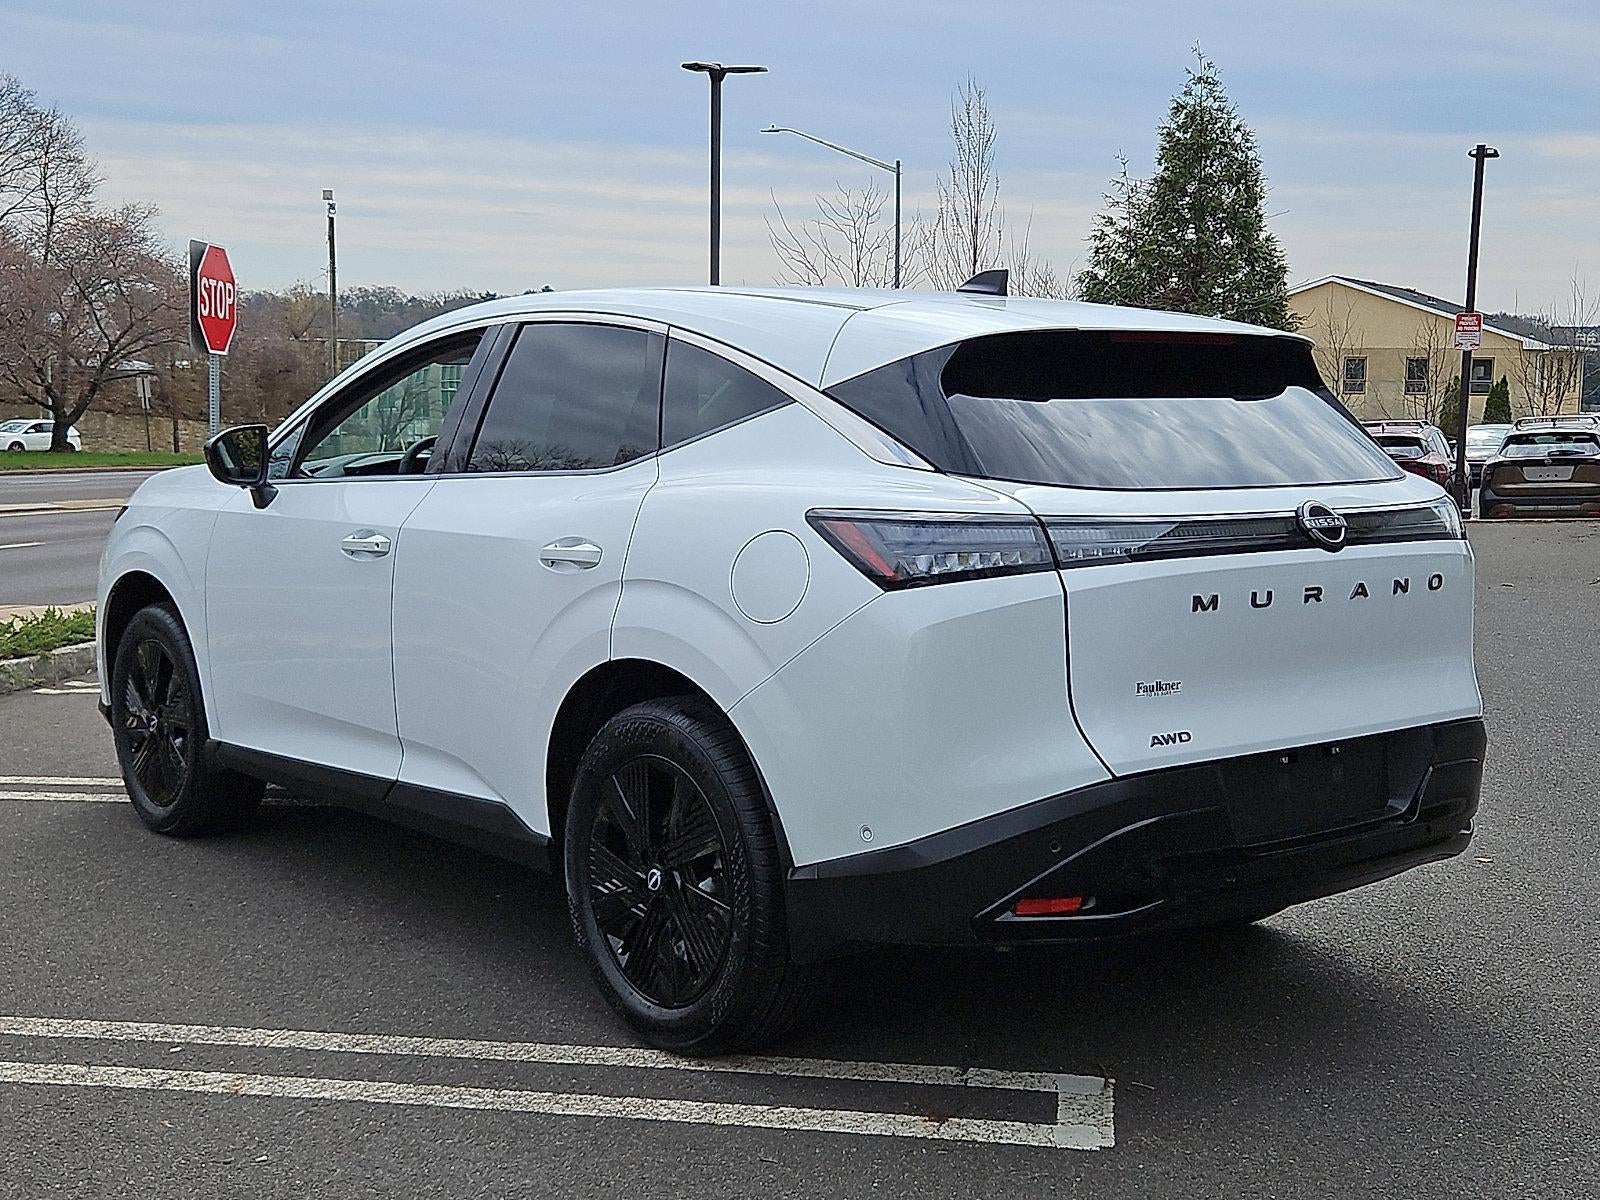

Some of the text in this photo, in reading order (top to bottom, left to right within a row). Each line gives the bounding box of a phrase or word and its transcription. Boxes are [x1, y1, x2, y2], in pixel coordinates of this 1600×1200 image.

[201, 276, 234, 320] STOP
[1305, 518, 1345, 528] NISSAN
[1191, 573, 1443, 613] MURANO
[1136, 681, 1181, 694] Faulkner
[1150, 732, 1192, 748] AWD
